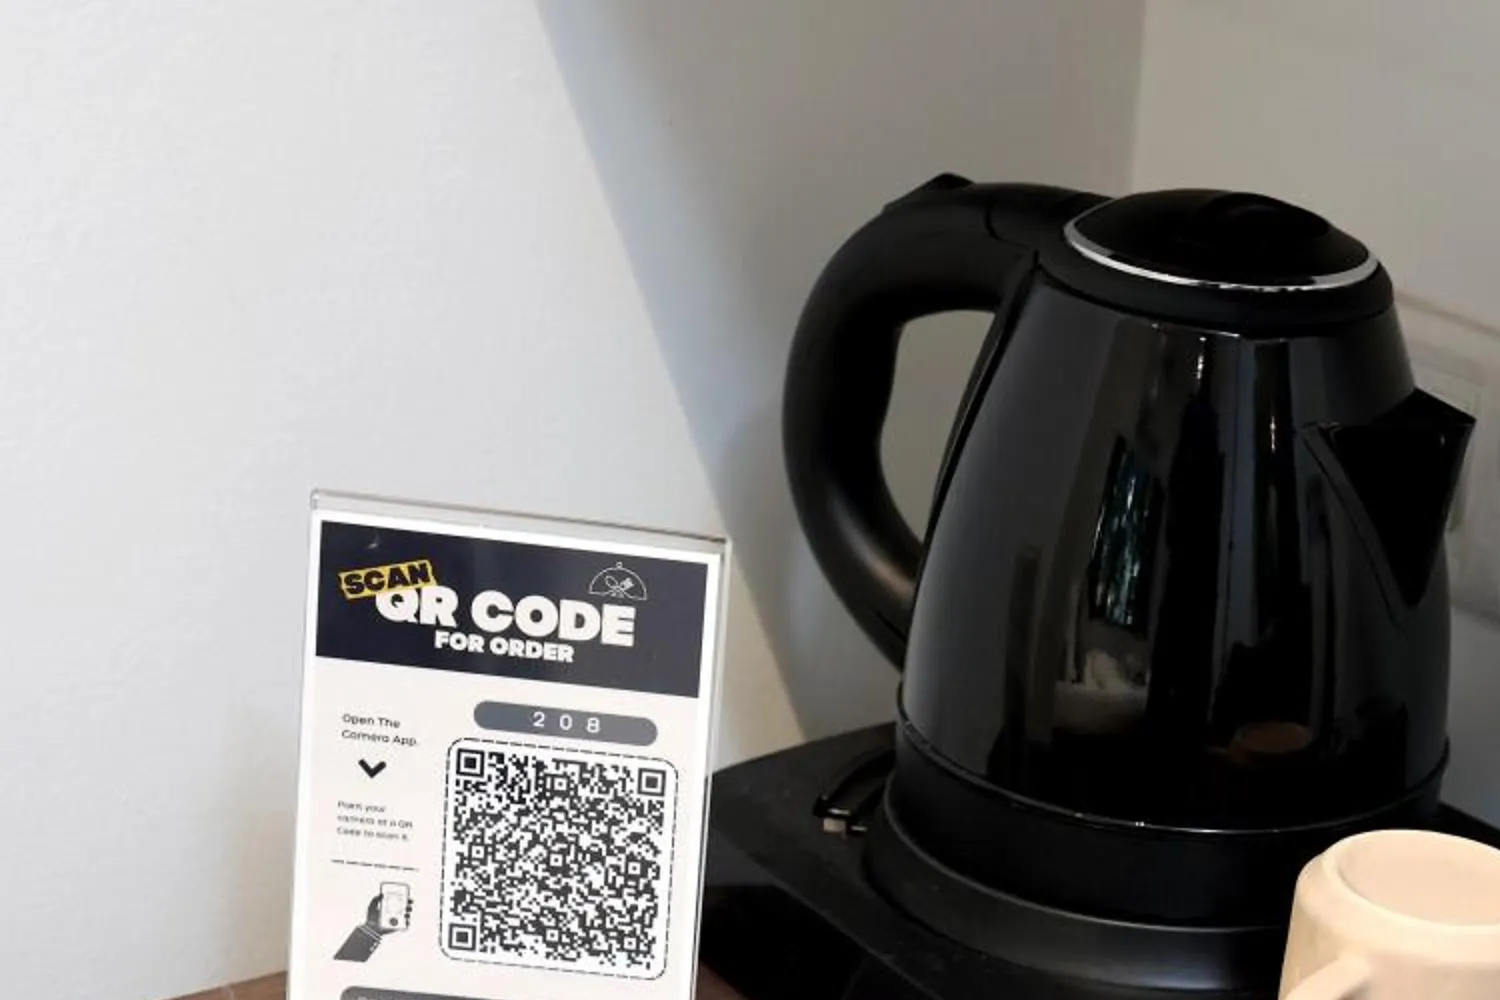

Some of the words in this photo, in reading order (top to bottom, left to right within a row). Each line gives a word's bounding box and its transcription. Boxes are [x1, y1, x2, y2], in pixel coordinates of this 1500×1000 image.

[343, 562, 430, 594] SCAN
[375, 585, 459, 628] QR
[471, 589, 636, 647] CODE
[434, 631, 484, 653] FOR
[489, 637, 575, 663] ORDER
[342, 713, 374, 725] Open
[378, 717, 401, 728] The
[392, 735, 417, 747] App
